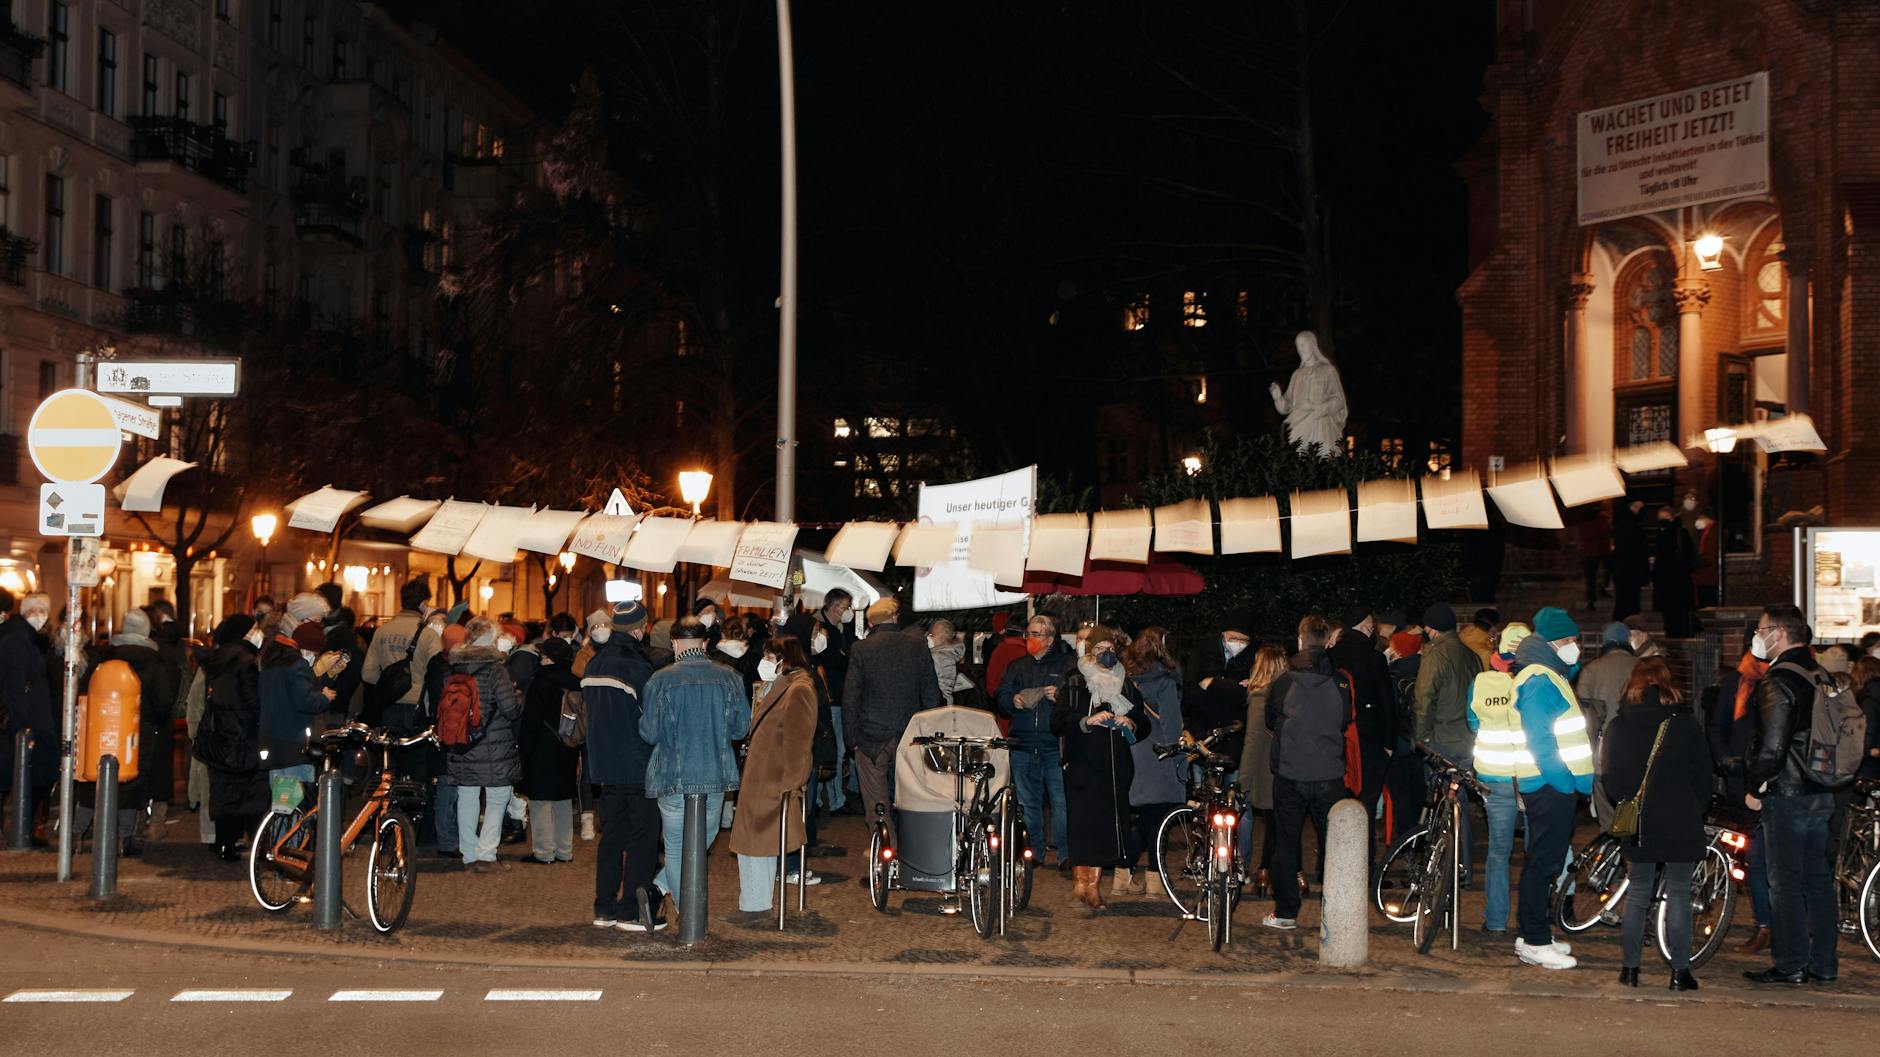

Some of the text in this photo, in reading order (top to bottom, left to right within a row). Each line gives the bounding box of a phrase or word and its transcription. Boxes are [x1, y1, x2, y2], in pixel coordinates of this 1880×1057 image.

[1590, 81, 1753, 134] WACHET UND BETET
[1606, 111, 1735, 156] FREIHEIT JETZT!
[1594, 164, 1607, 175] die
[1717, 138, 1733, 150] der
[1736, 132, 1764, 147] Türkei
[1639, 181, 1669, 197] Täglich
[1681, 175, 1698, 187] Uhr
[946, 502, 973, 513] Unser
[974, 499, 1017, 511] heutiger
[575, 538, 621, 558] NO FUN
[738, 545, 788, 560] FAMILIEN
[1485, 696, 1509, 707] ORD
